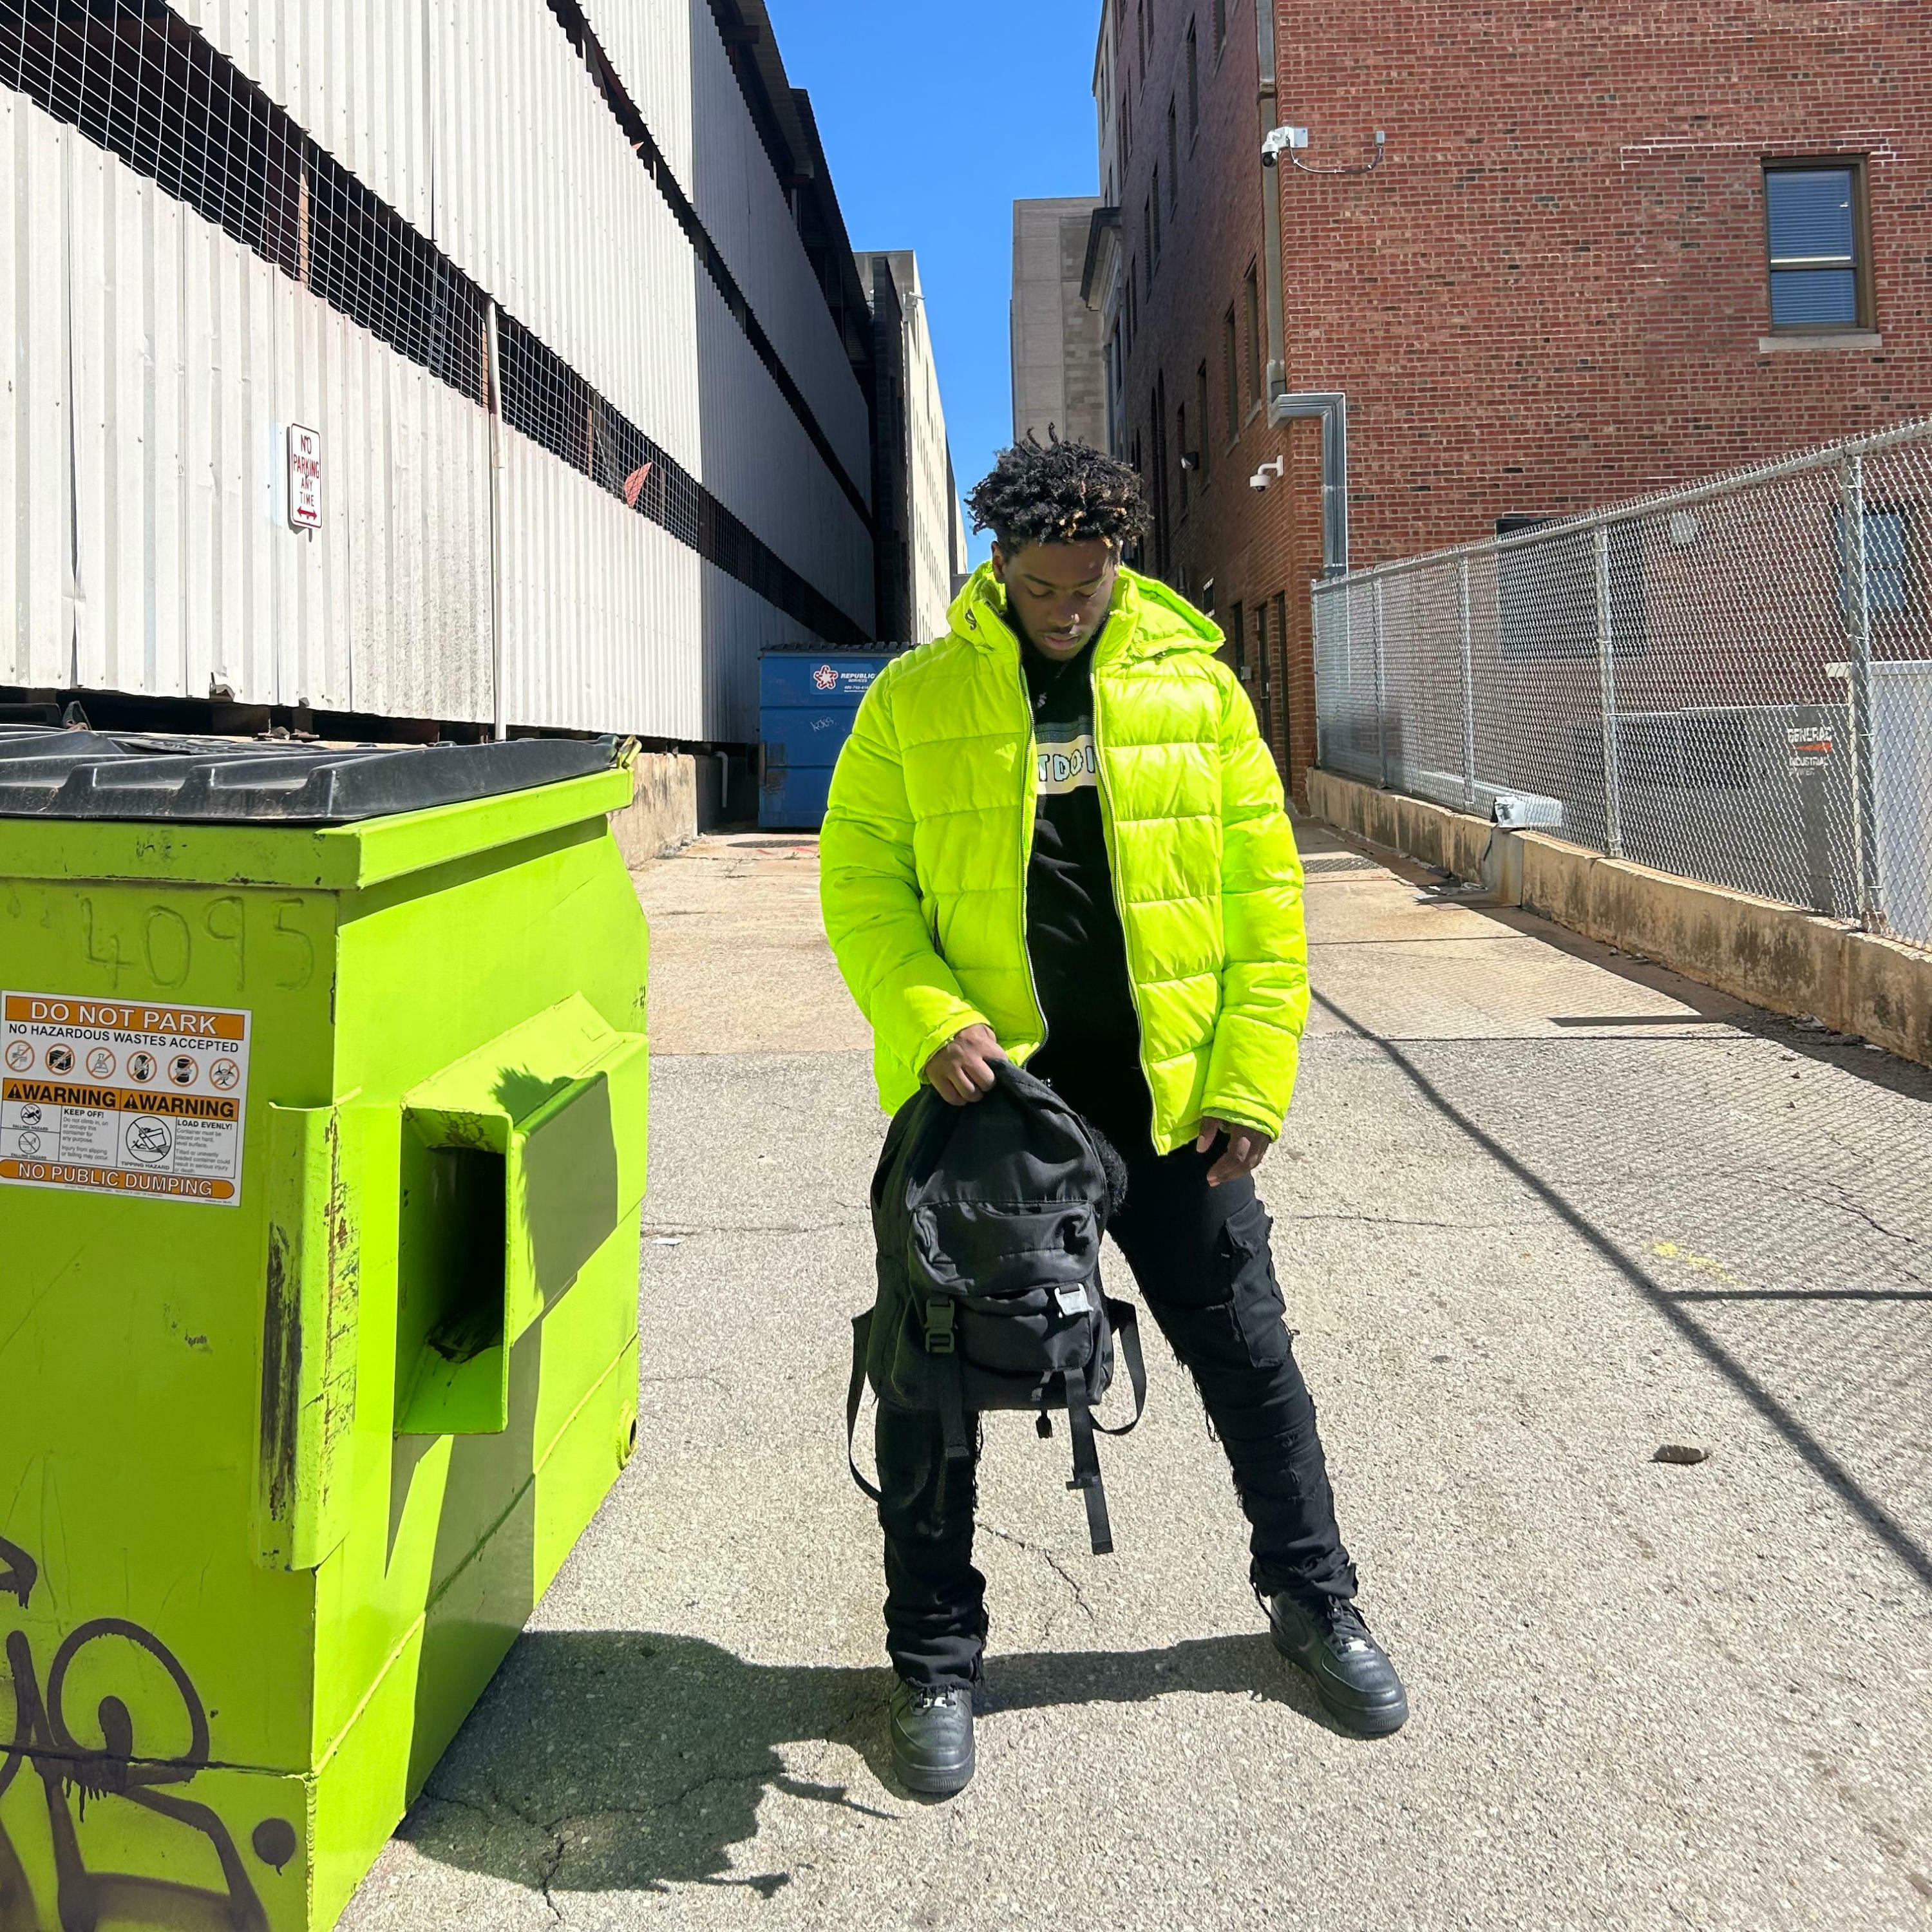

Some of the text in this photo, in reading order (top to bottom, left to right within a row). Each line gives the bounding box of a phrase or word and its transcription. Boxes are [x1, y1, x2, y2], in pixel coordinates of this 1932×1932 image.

[300, 434, 312, 454] NO
[294, 453, 319, 478] PARKING
[301, 477, 312, 491] ANY
[299, 491, 314, 507] TIME
[1787, 726, 1832, 743] GENERAC
[31, 1001, 218, 1035] DO NOT PARK
[9, 1023, 238, 1053] NO HAZARDOUS WASTES ACCEPTED
[22, 1084, 116, 1108] WARNING
[139, 1094, 234, 1118] WARNING
[87, 1110, 104, 1119] OFF!
[201, 1121, 232, 1130] EVENLY!
[18, 1162, 45, 1179] NO
[52, 1166, 119, 1187] PUBLIC
[125, 1173, 213, 1196] DUMPING
